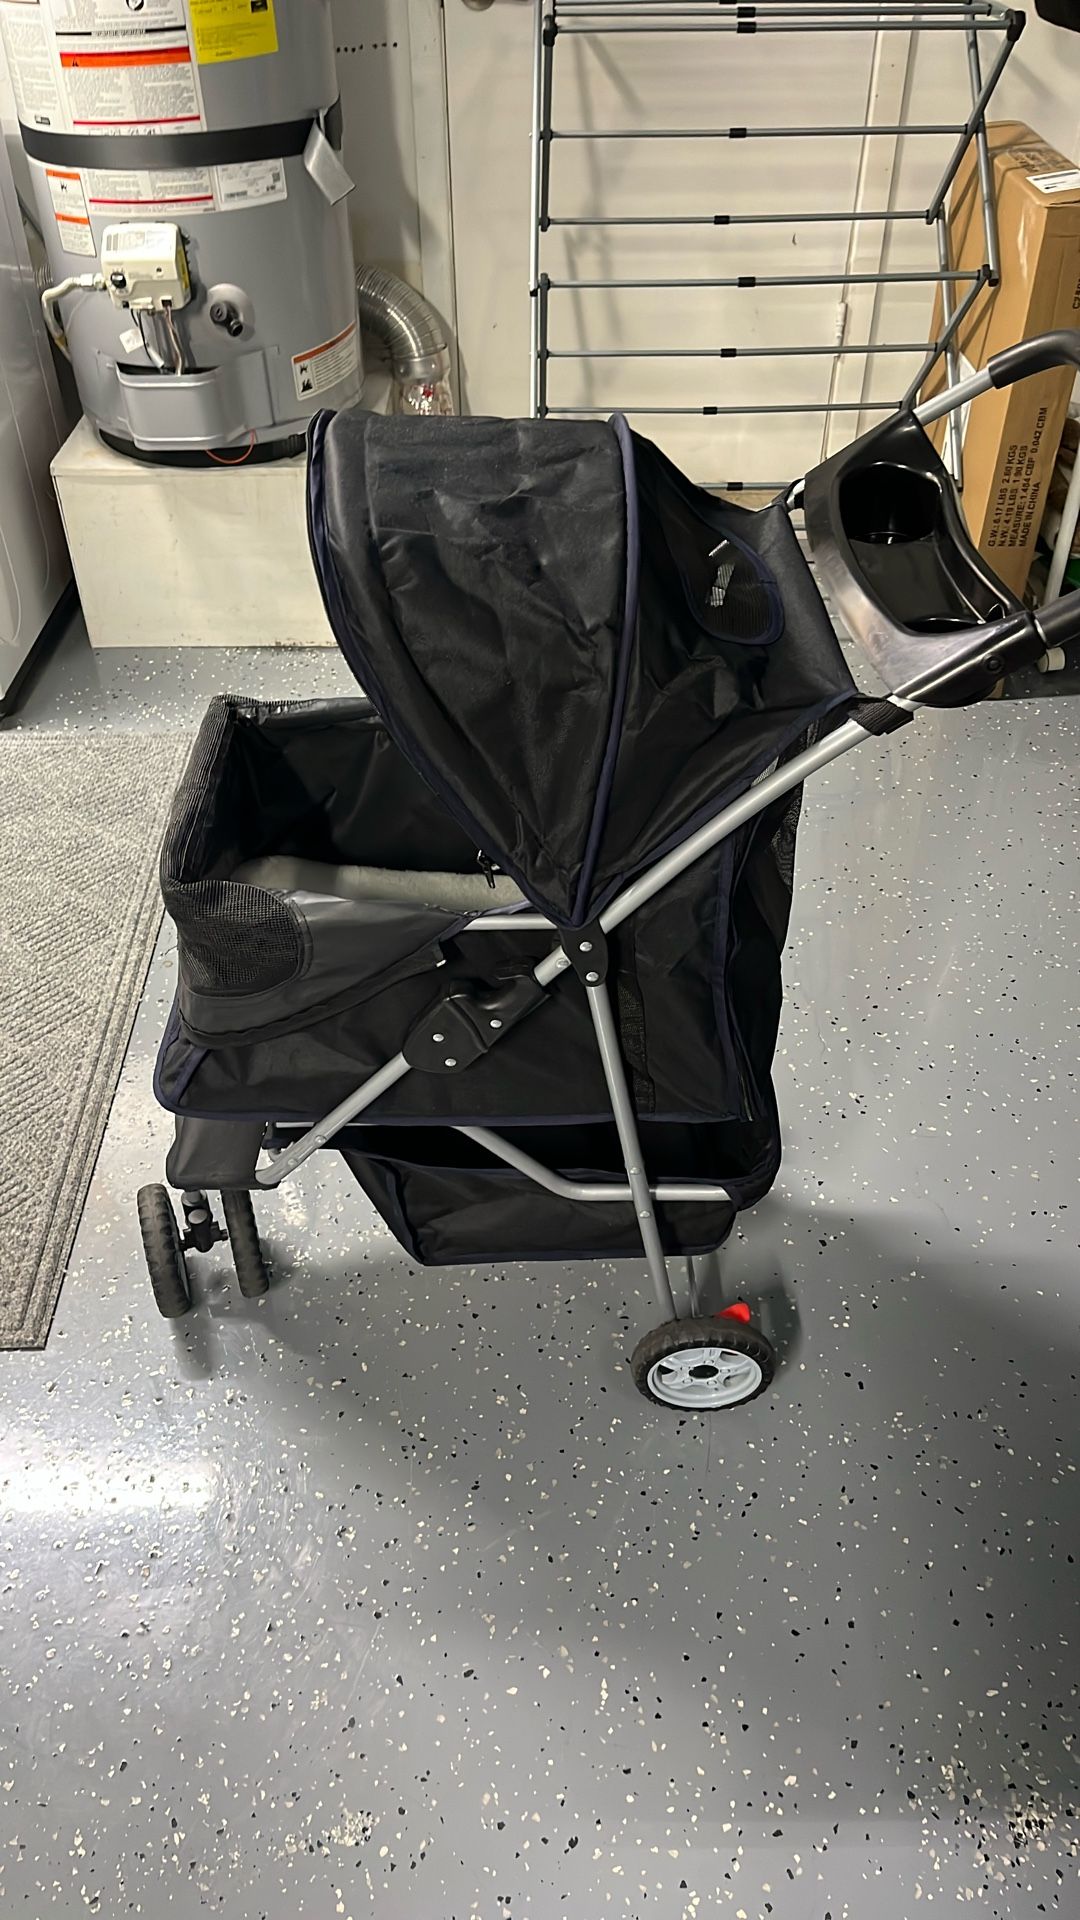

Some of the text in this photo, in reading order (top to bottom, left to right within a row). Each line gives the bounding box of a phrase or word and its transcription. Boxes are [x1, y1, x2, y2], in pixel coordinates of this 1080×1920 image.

[997, 488, 1008, 505] LBS
[1007, 445, 1018, 464] KGS
[1008, 501, 1026, 547] MEASURE:
[1037, 407, 1048, 428] CBM
[1008, 488, 1018, 506] LBS
[1018, 481, 1041, 547] MADE IN CHINA
